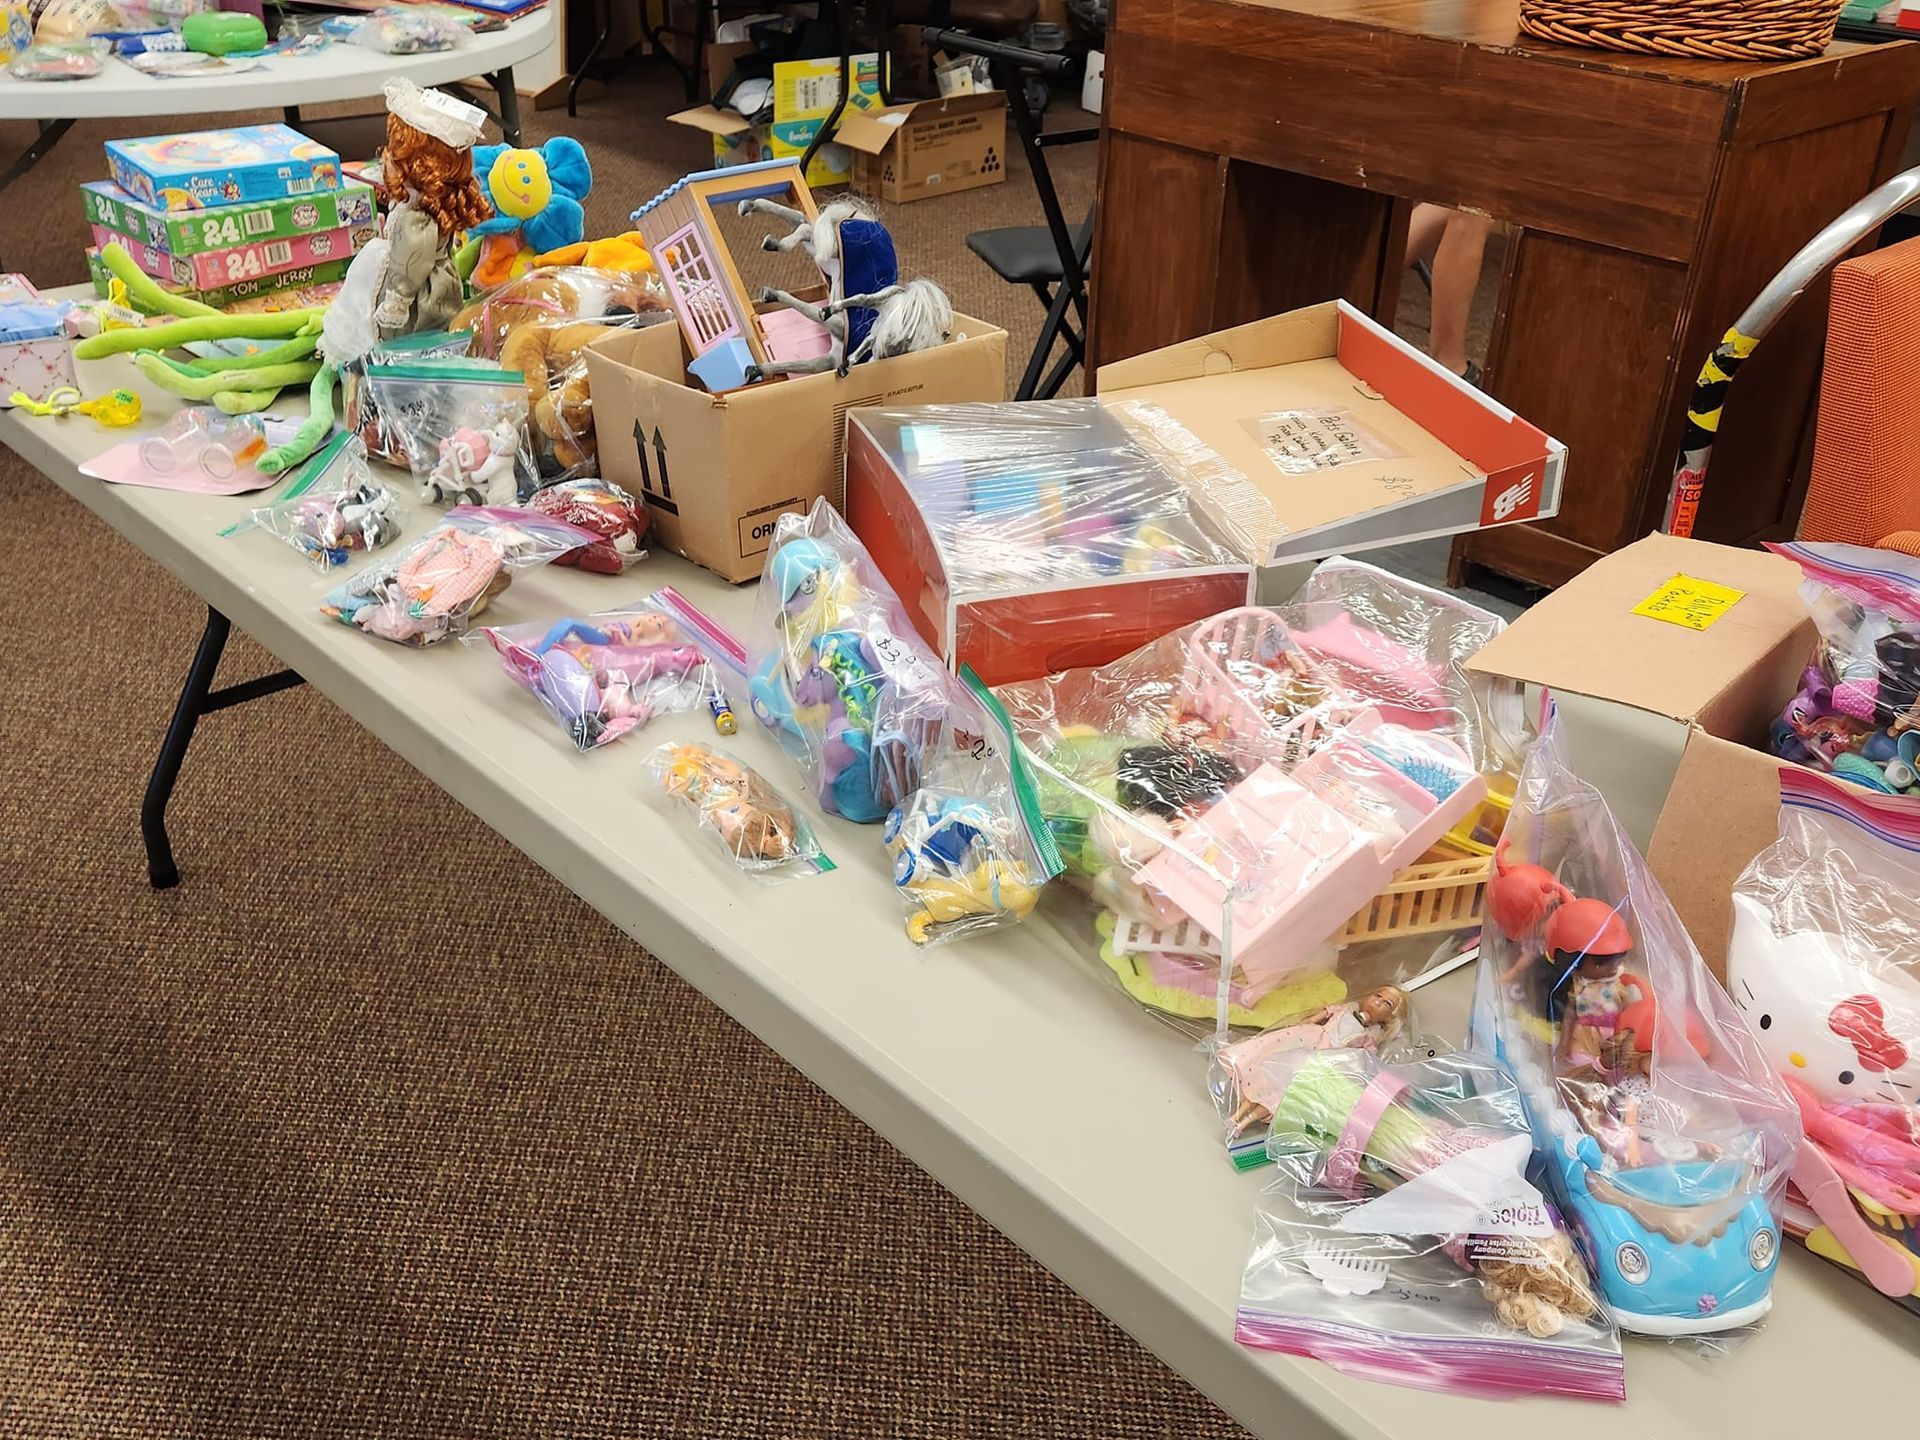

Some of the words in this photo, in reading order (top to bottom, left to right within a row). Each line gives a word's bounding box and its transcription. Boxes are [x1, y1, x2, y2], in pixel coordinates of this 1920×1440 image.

[203, 219, 240, 247] 24
[226, 250, 260, 279] 24
[228, 283, 259, 297] TOM
[275, 268, 315, 289] JERRY
[1491, 1202, 1544, 1227] Ziploc
[1473, 1245, 1506, 1256] Company
